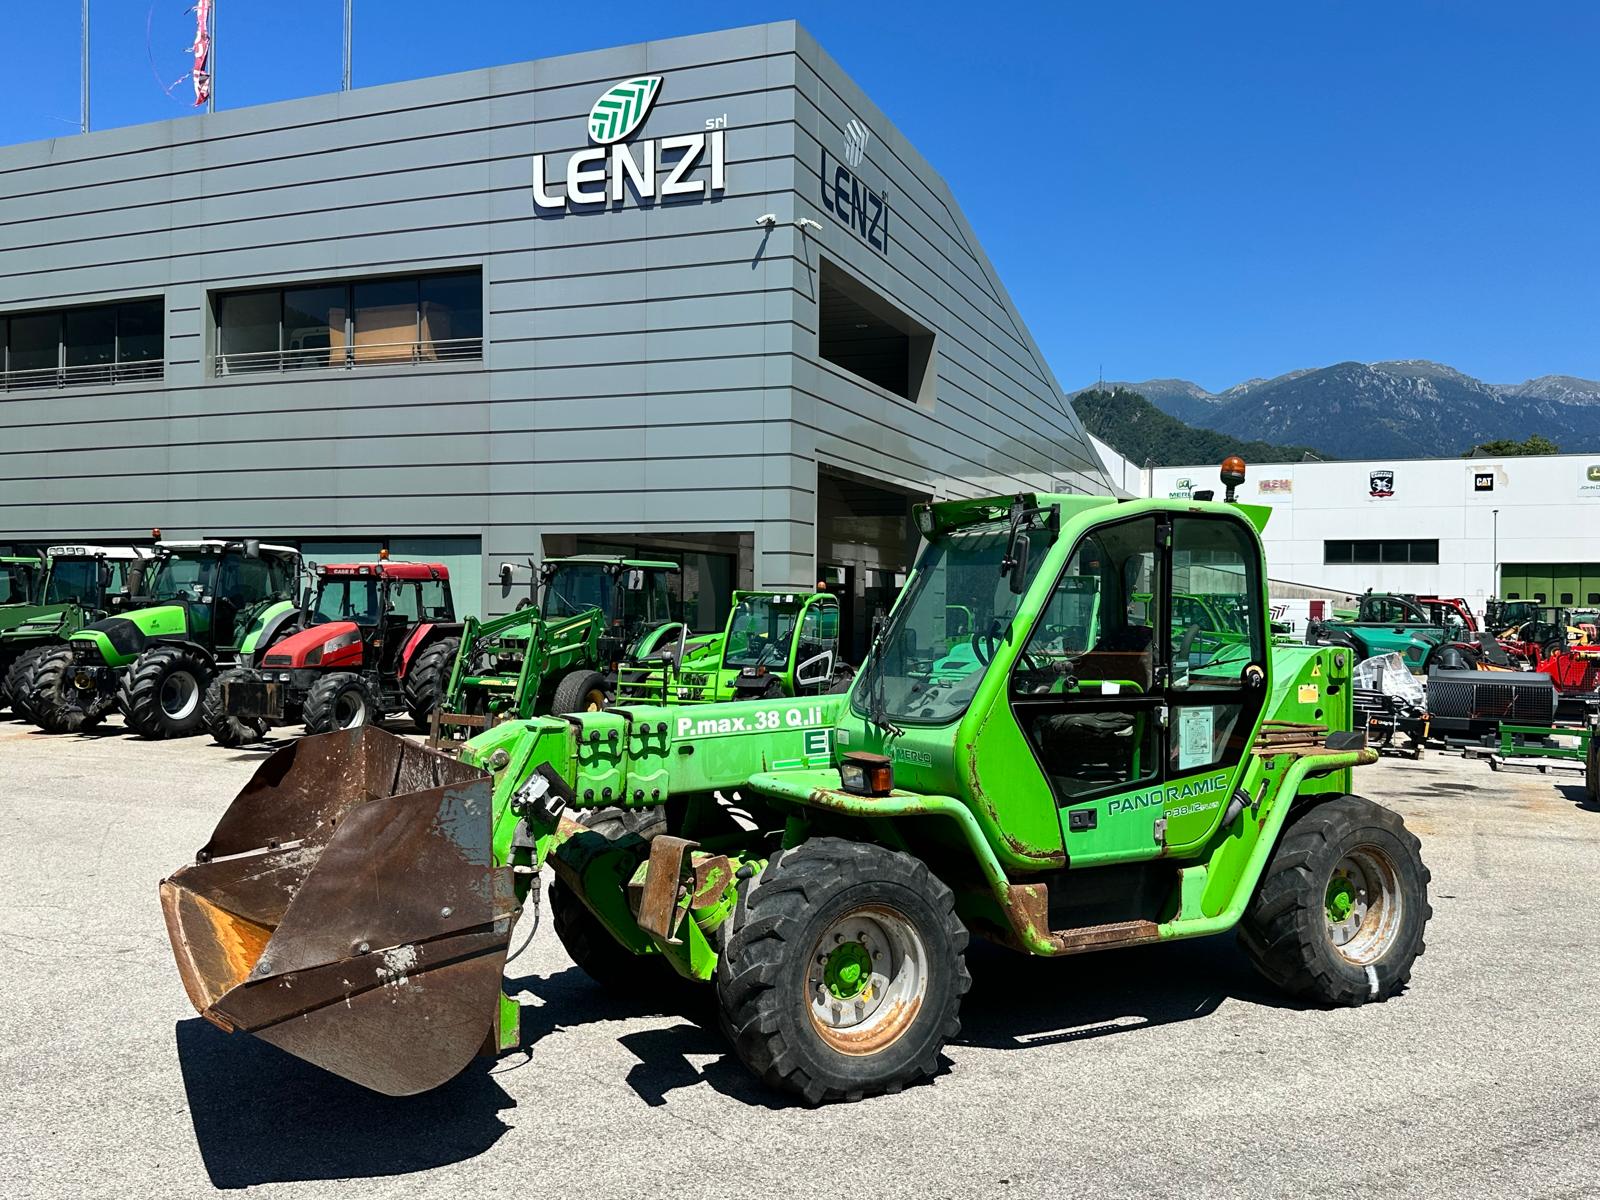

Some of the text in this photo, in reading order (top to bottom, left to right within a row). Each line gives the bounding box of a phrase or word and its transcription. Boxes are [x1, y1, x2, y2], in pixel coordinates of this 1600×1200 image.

[706, 114, 727, 130] srl
[532, 130, 725, 208] LENZI
[821, 147, 888, 256] LENZI
[1476, 477, 1492, 487] CAT
[1168, 491, 1195, 499] MERL
[785, 705, 823, 727] Q.li
[1107, 774, 1228, 816] PANORAMIC
